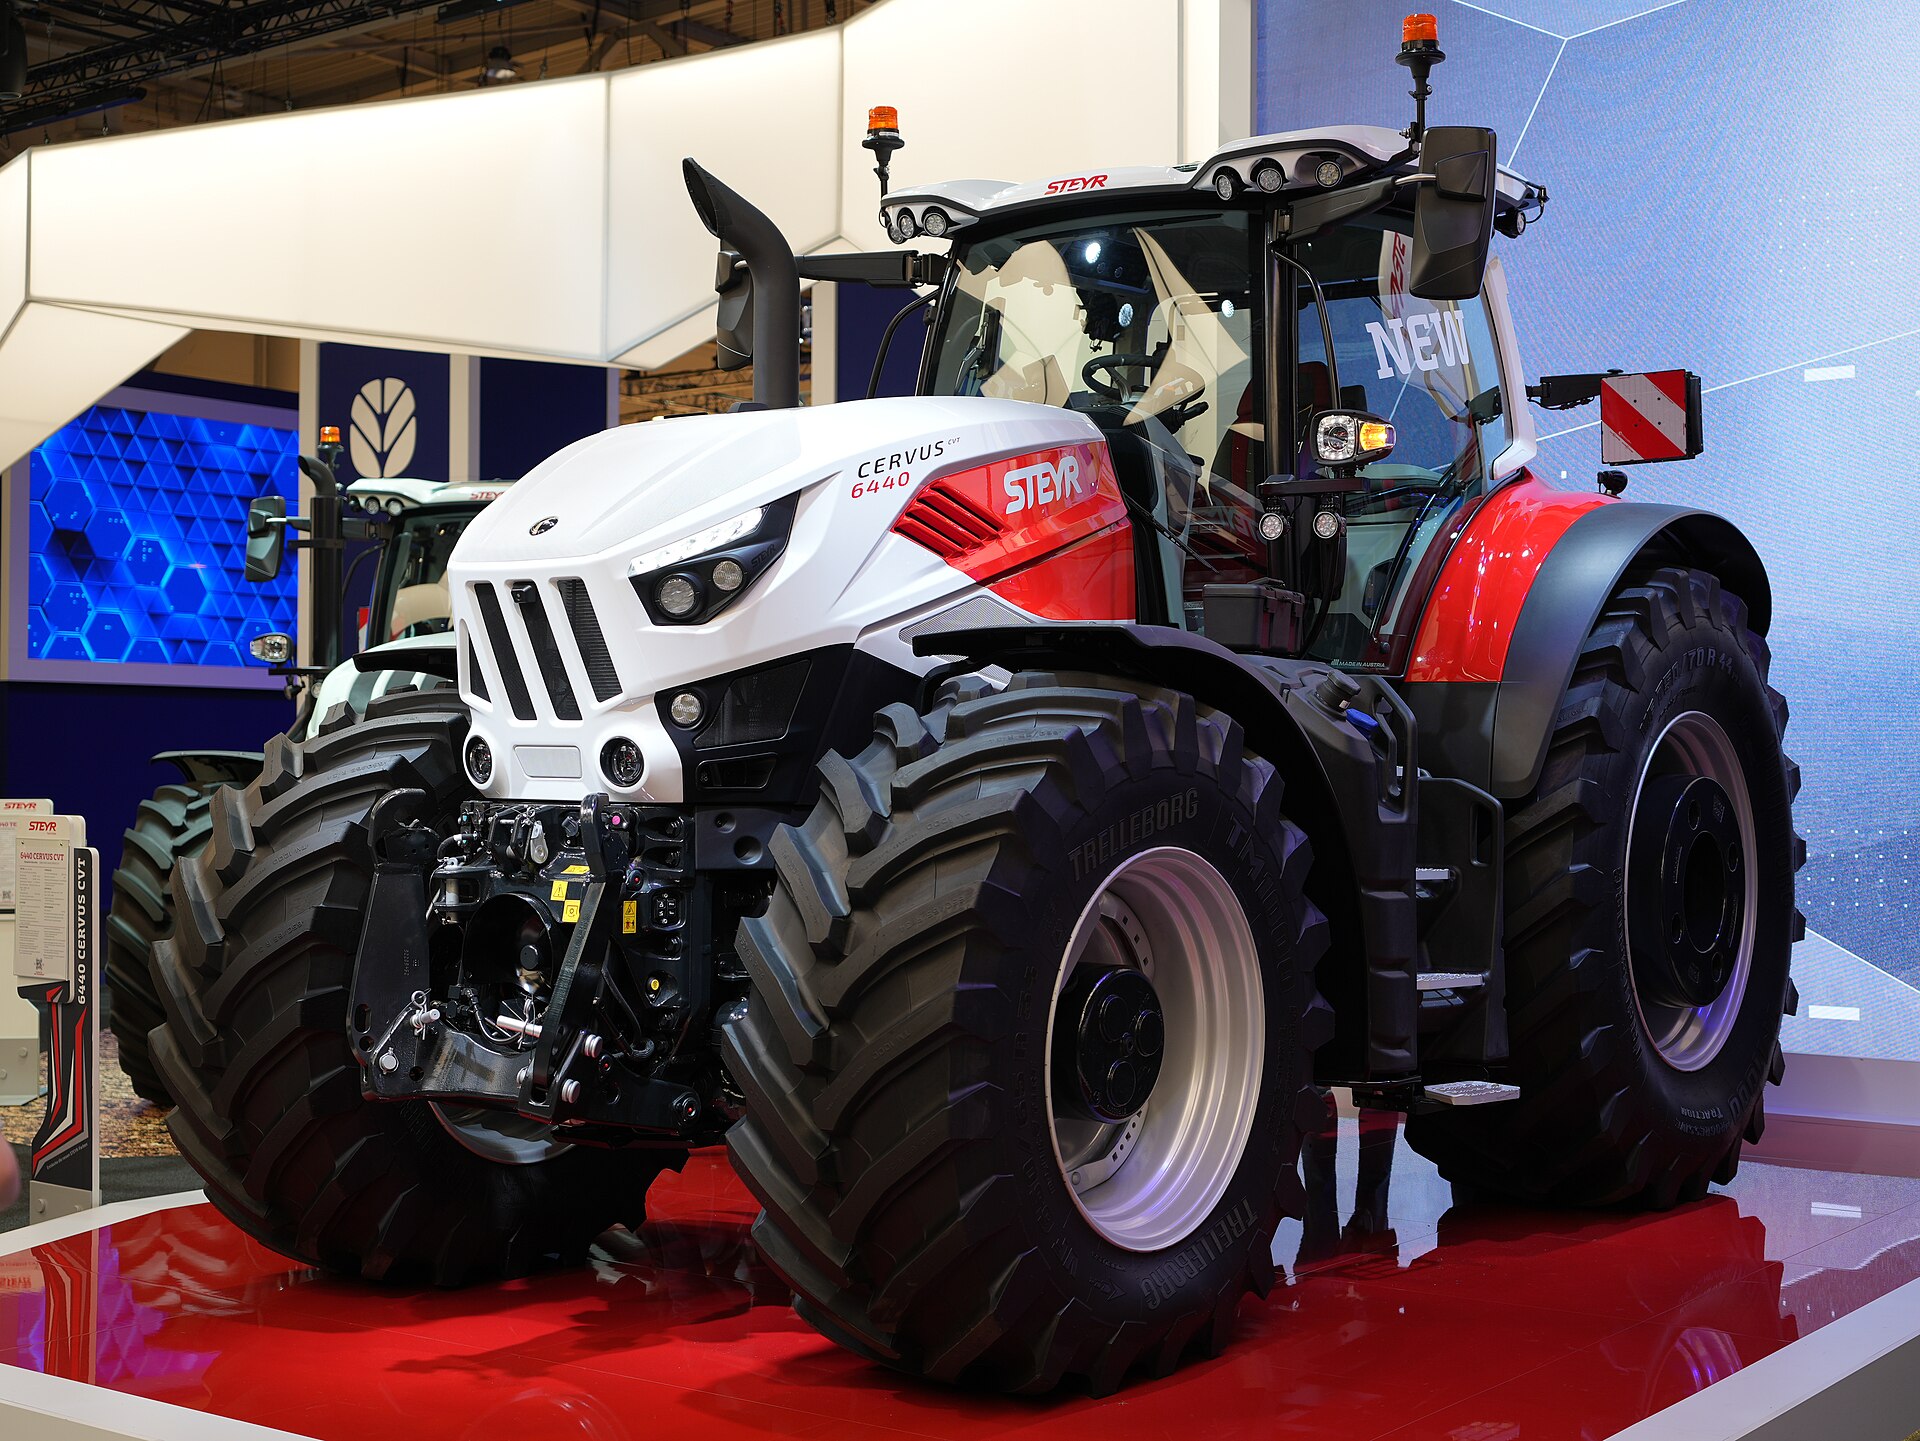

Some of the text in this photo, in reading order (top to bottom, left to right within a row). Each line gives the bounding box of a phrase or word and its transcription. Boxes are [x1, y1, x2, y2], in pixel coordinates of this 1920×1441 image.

[1044, 174, 1108, 195] STEYR
[1364, 309, 1470, 380] NEW
[857, 436, 961, 478] CERVUS CVT
[470, 491, 505, 500] STEY
[851, 471, 910, 499] 6440
[1003, 455, 1083, 514] STEYR
[751, 543, 775, 568] STEYR
[3, 801, 37, 809] STEYR
[28, 820, 57, 832] STEYR
[1067, 787, 1199, 882] TRELLEBORG
[20, 851, 65, 861] 6440 CERVUS CVT
[77, 857, 86, 1005] 6440 CERVUS CVT
[1680, 1106, 1724, 1120] TRACTION
[1142, 1197, 1259, 1311] TRELLEBORG
